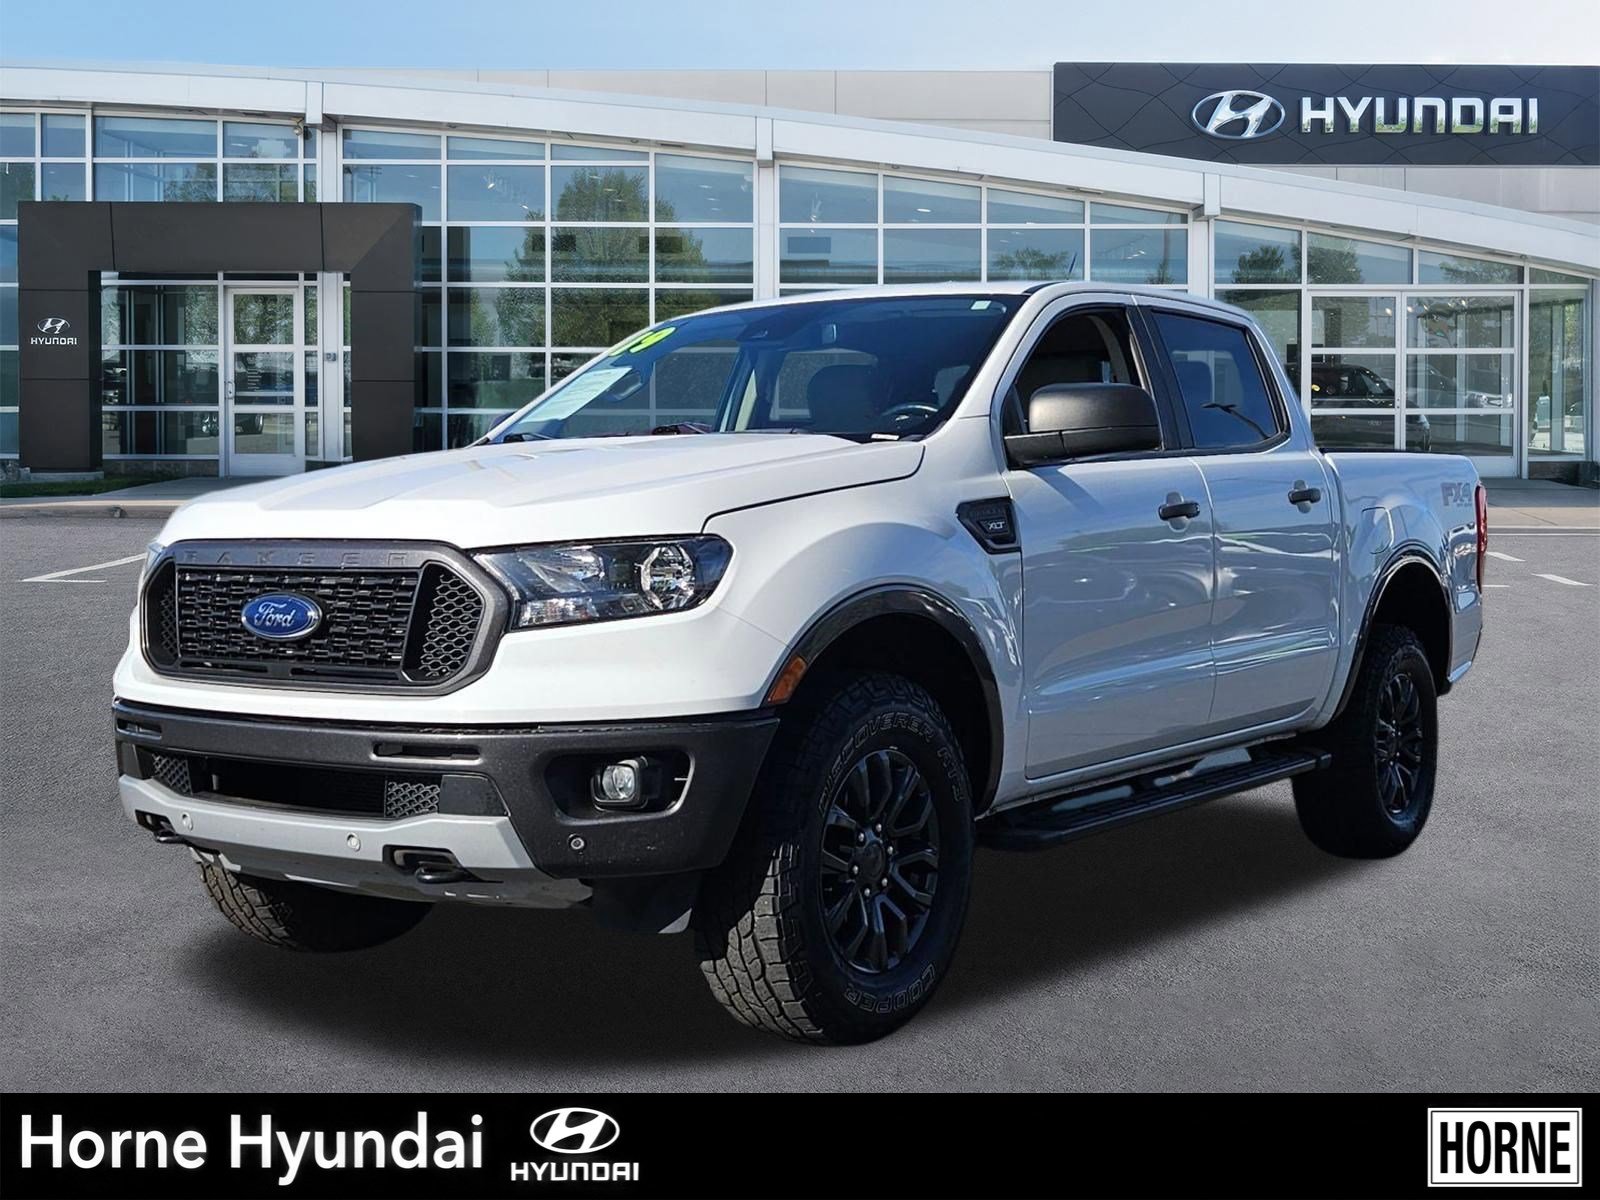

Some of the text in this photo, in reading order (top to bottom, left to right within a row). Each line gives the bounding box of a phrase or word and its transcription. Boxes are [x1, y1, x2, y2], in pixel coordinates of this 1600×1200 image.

[1301, 96, 1539, 134] HYUNDAI
[30, 336, 78, 346] HYUNDAI
[1440, 482, 1473, 506] FX4
[253, 601, 295, 628] Ford
[843, 963, 936, 1014] COOPER
